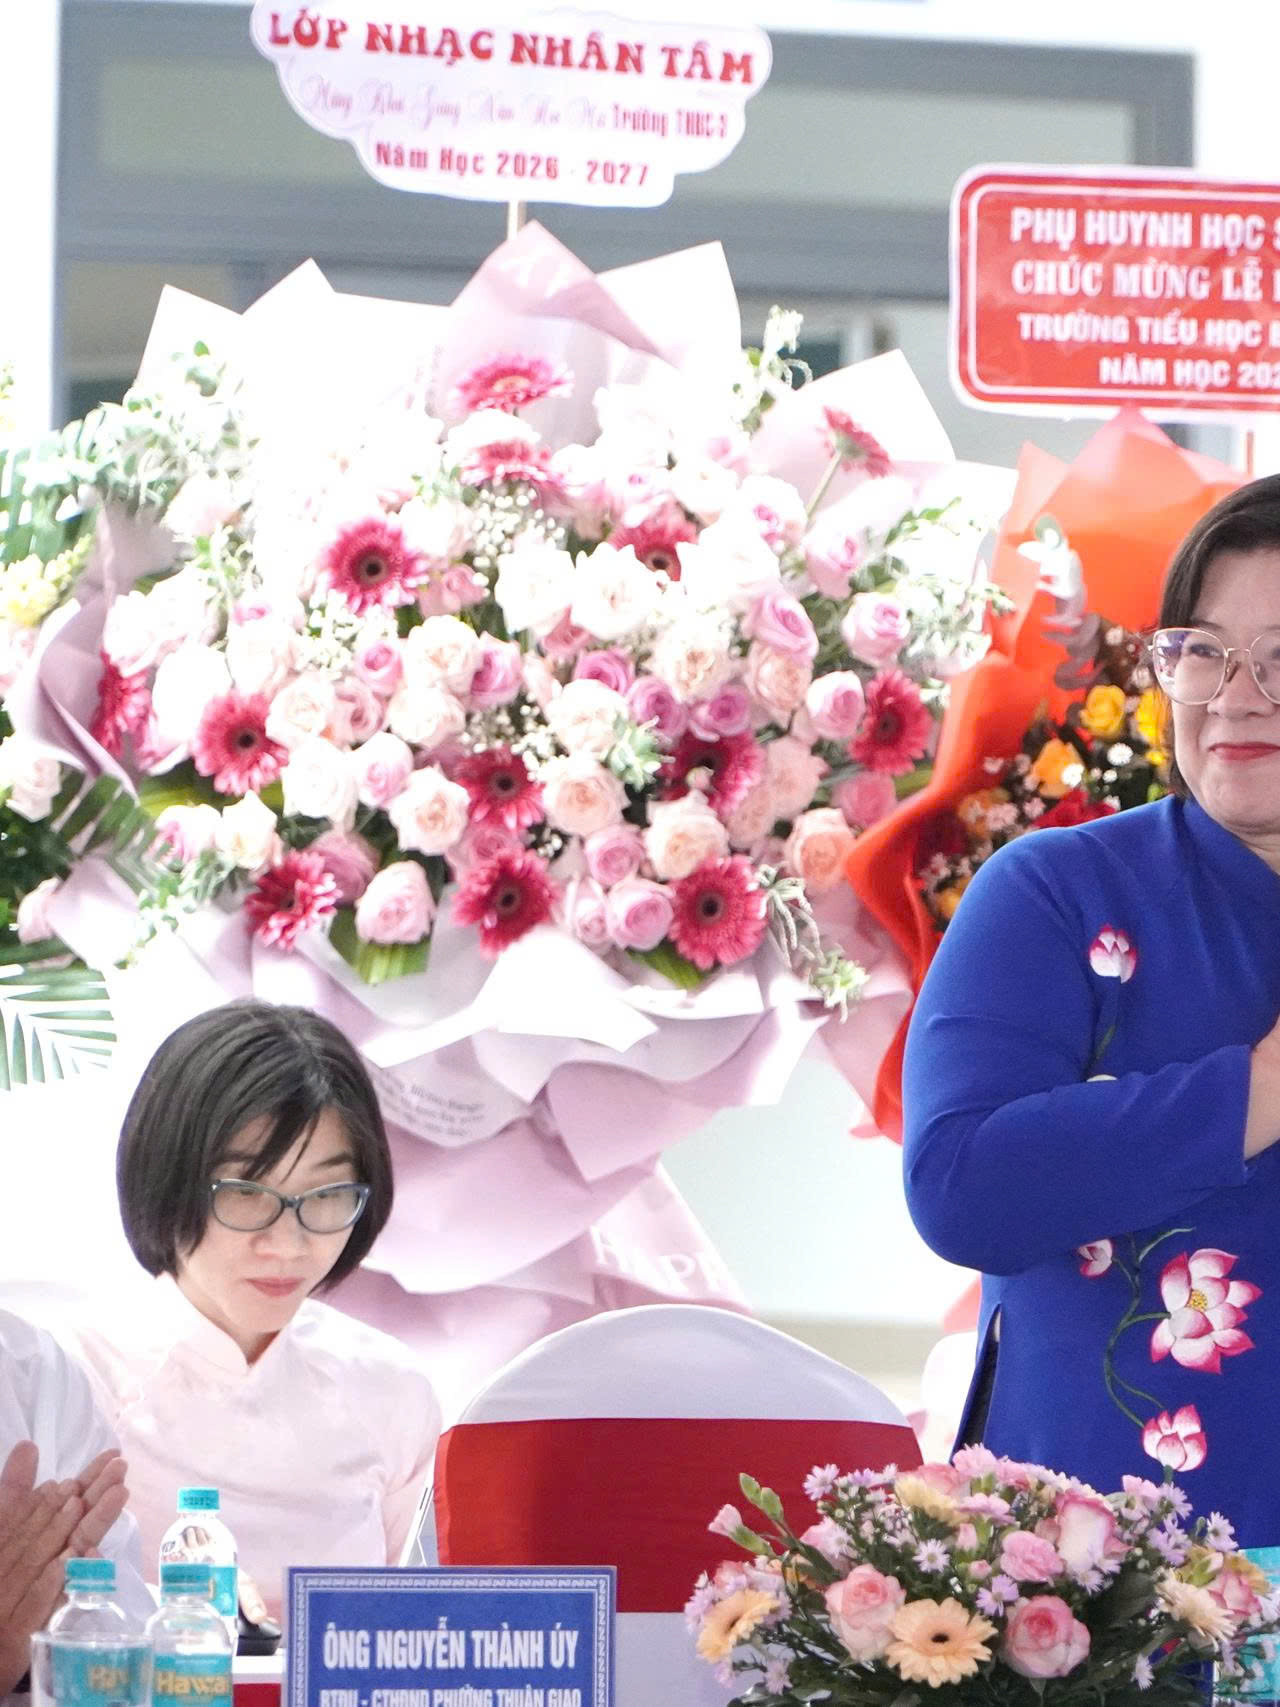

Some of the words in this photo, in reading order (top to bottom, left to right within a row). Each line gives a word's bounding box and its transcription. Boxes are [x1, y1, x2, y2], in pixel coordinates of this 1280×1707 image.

[269, 8, 348, 49] LỚP
[365, 22, 493, 66] NHẠC
[510, 31, 645, 74] NHÂN
[660, 40, 753, 84] TÂM
[439, 147, 485, 176] Học
[497, 152, 559, 180] 2026
[586, 159, 648, 186] 2027
[1010, 206, 1077, 251] PHỤ
[1084, 209, 1193, 248] HUYNH
[1201, 213, 1266, 256] HỌC
[1011, 254, 1103, 297] CHÚC
[1112, 256, 1212, 300] MỪNG
[1221, 255, 1263, 302] LỄ
[1016, 308, 1130, 343] TRƯỜNG
[1203, 318, 1262, 353] HỌC
[1099, 352, 1167, 386] NĂM
[1172, 359, 1231, 392] HỌC
[323, 1621, 370, 1669] ÔNG
[375, 1616, 466, 1669] NGUYỄN
[471, 1621, 544, 1668] THÀNH
[551, 1622, 579, 1669] ÚY
